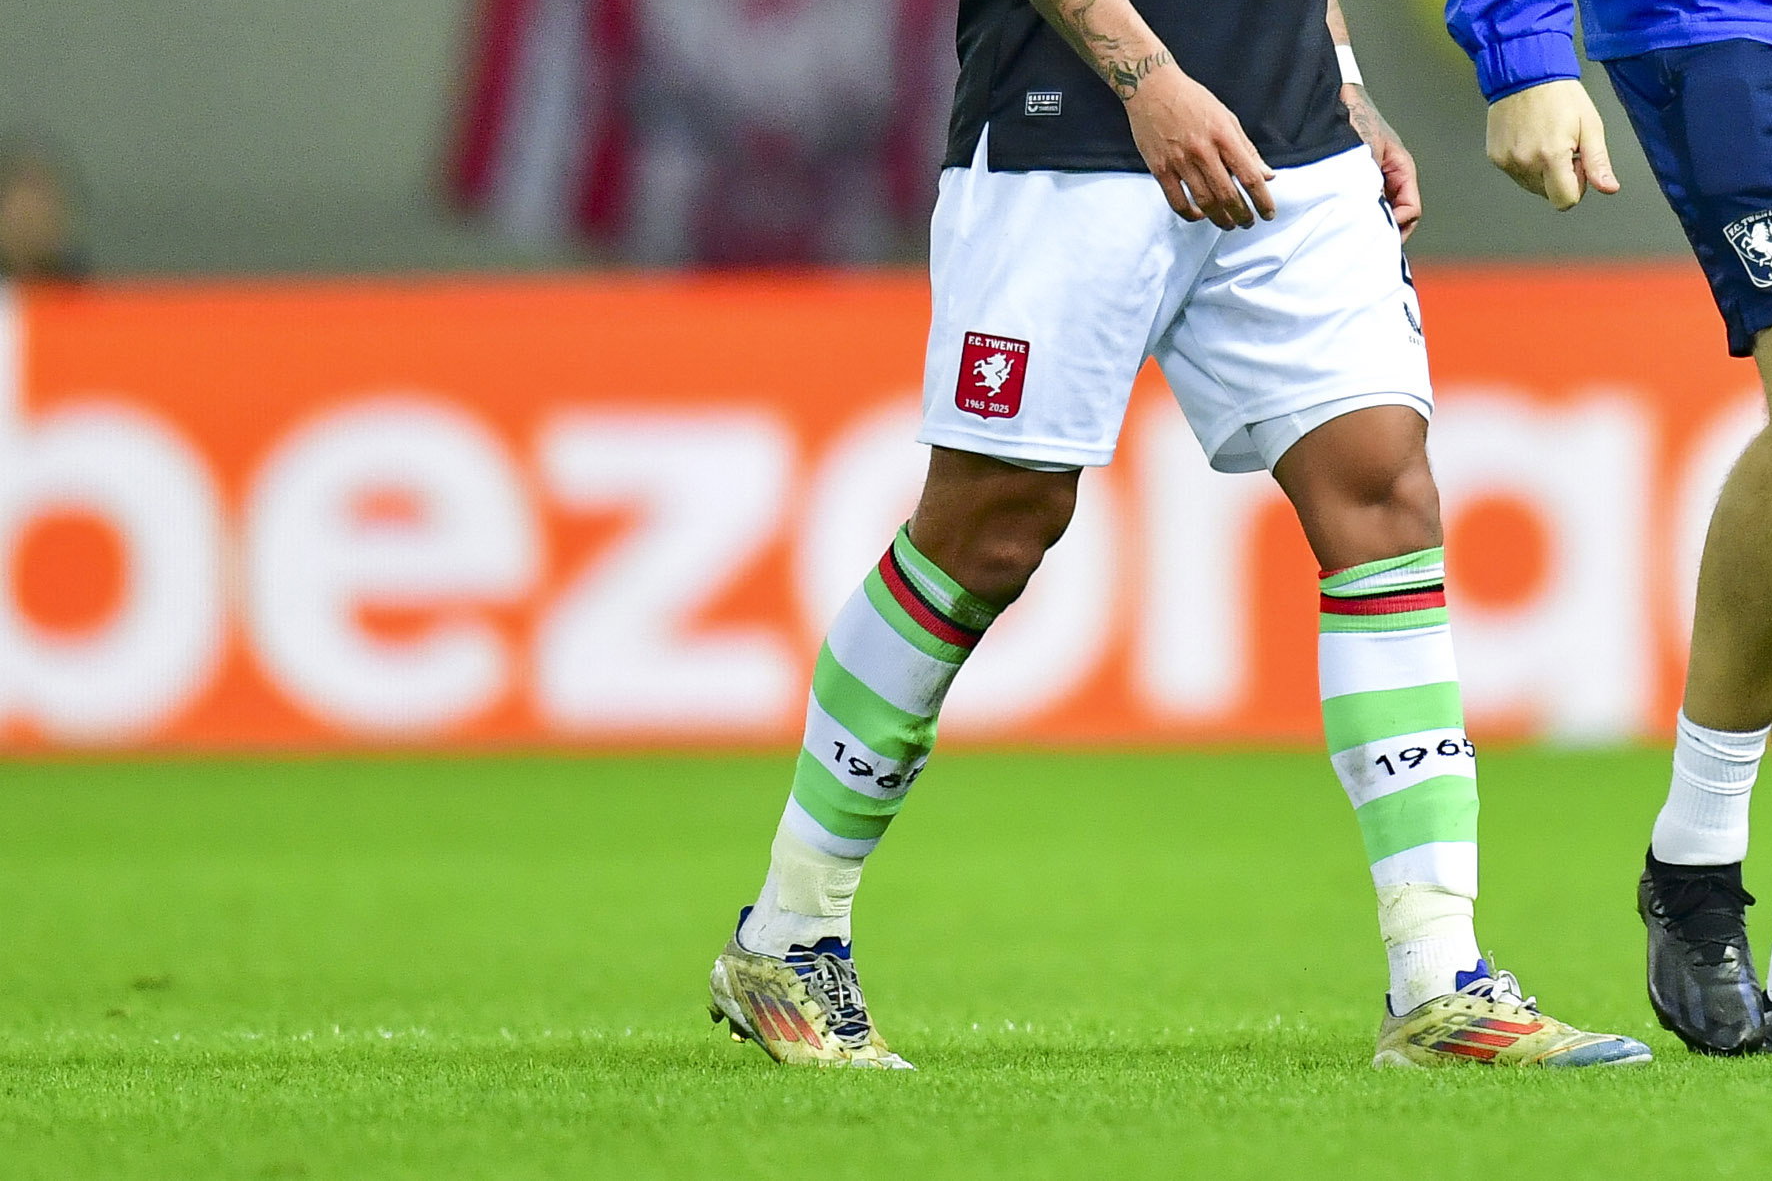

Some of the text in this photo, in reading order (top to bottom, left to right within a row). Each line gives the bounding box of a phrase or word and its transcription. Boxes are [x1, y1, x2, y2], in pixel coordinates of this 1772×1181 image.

[967, 335, 1027, 355] F.C. TWENTE
[964, 398, 1010, 414] 1965 2025
[1375, 738, 1476, 776] 1965
